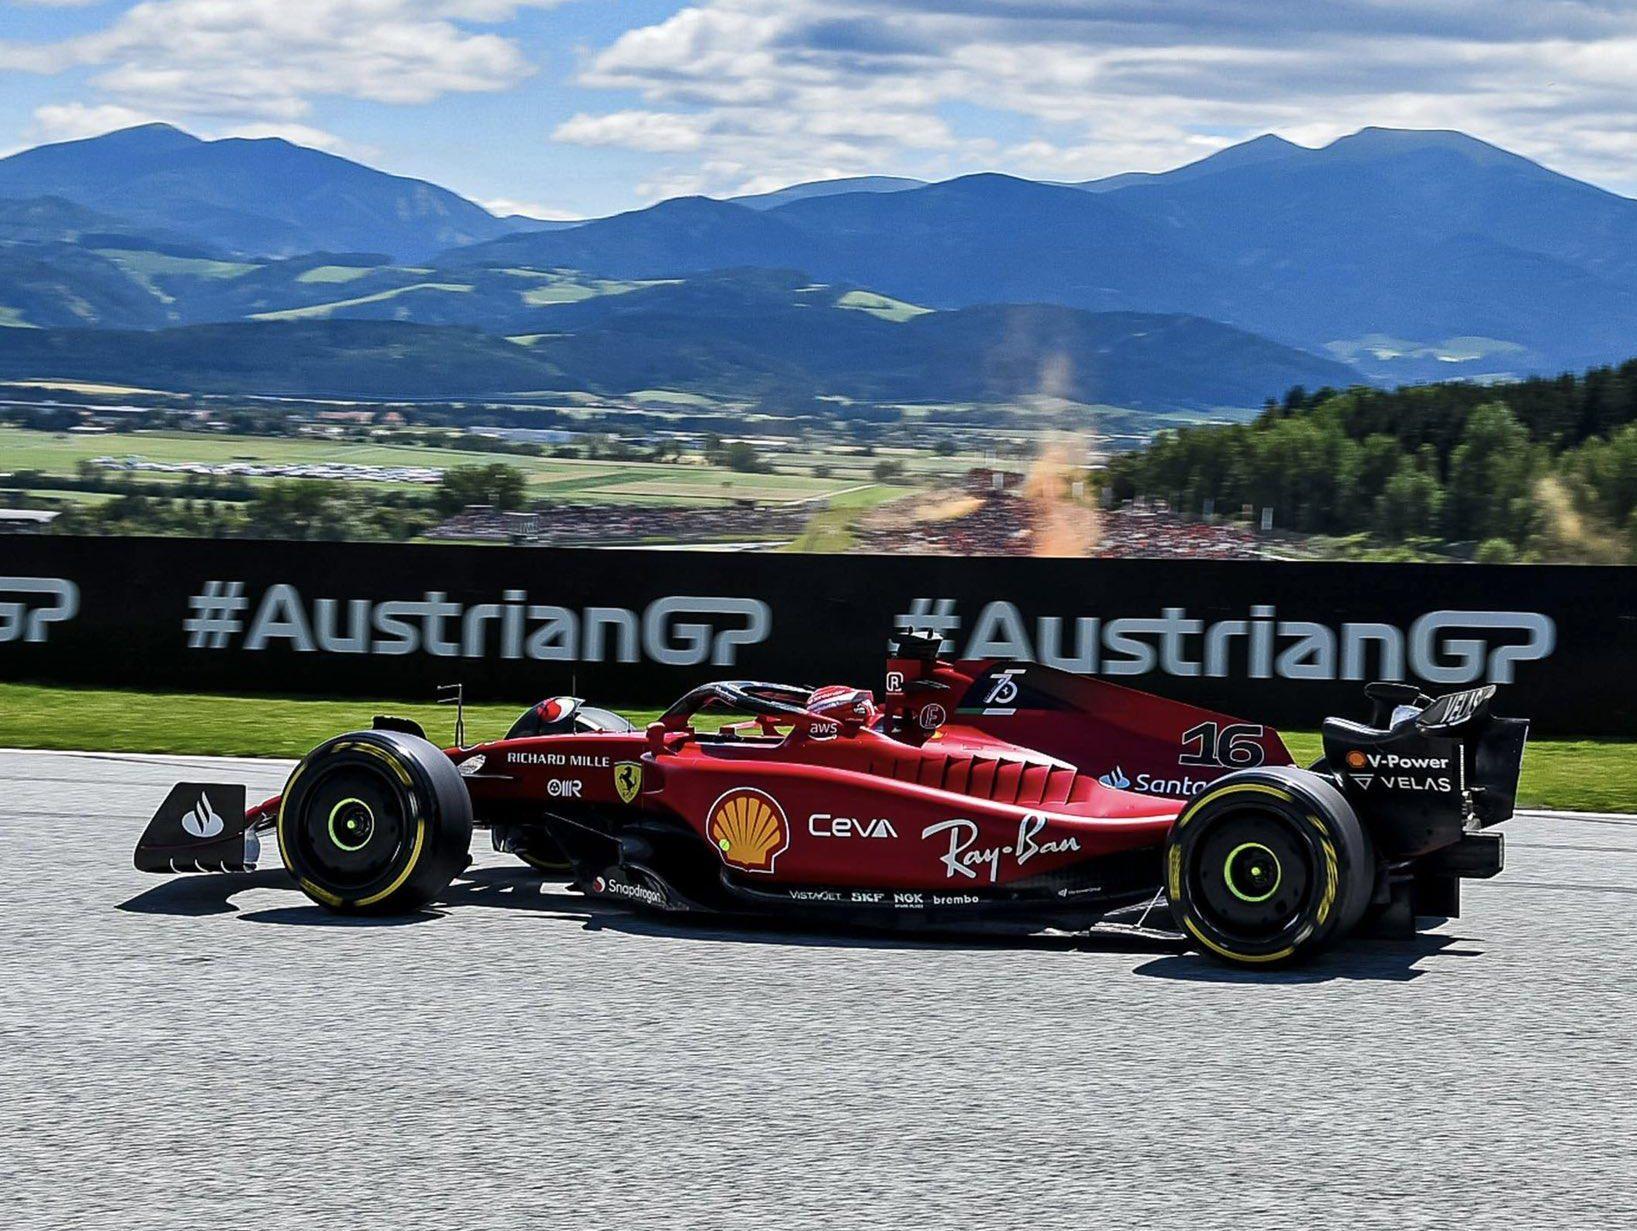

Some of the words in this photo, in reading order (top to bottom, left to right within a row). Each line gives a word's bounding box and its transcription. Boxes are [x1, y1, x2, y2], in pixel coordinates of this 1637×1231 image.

[183, 580, 773, 666] #AustrianGP
[810, 723, 838, 734] aws
[1178, 721, 1264, 769] 16
[507, 752, 566, 765] RICHARD
[569, 755, 610, 768] MILLE
[1367, 754, 1449, 769] V-Power
[1134, 774, 1206, 795] Santa
[1380, 776, 1451, 792] VELAS
[851, 892, 885, 903] SKF
[894, 893, 924, 903] NGK
[933, 894, 979, 905] brembo
